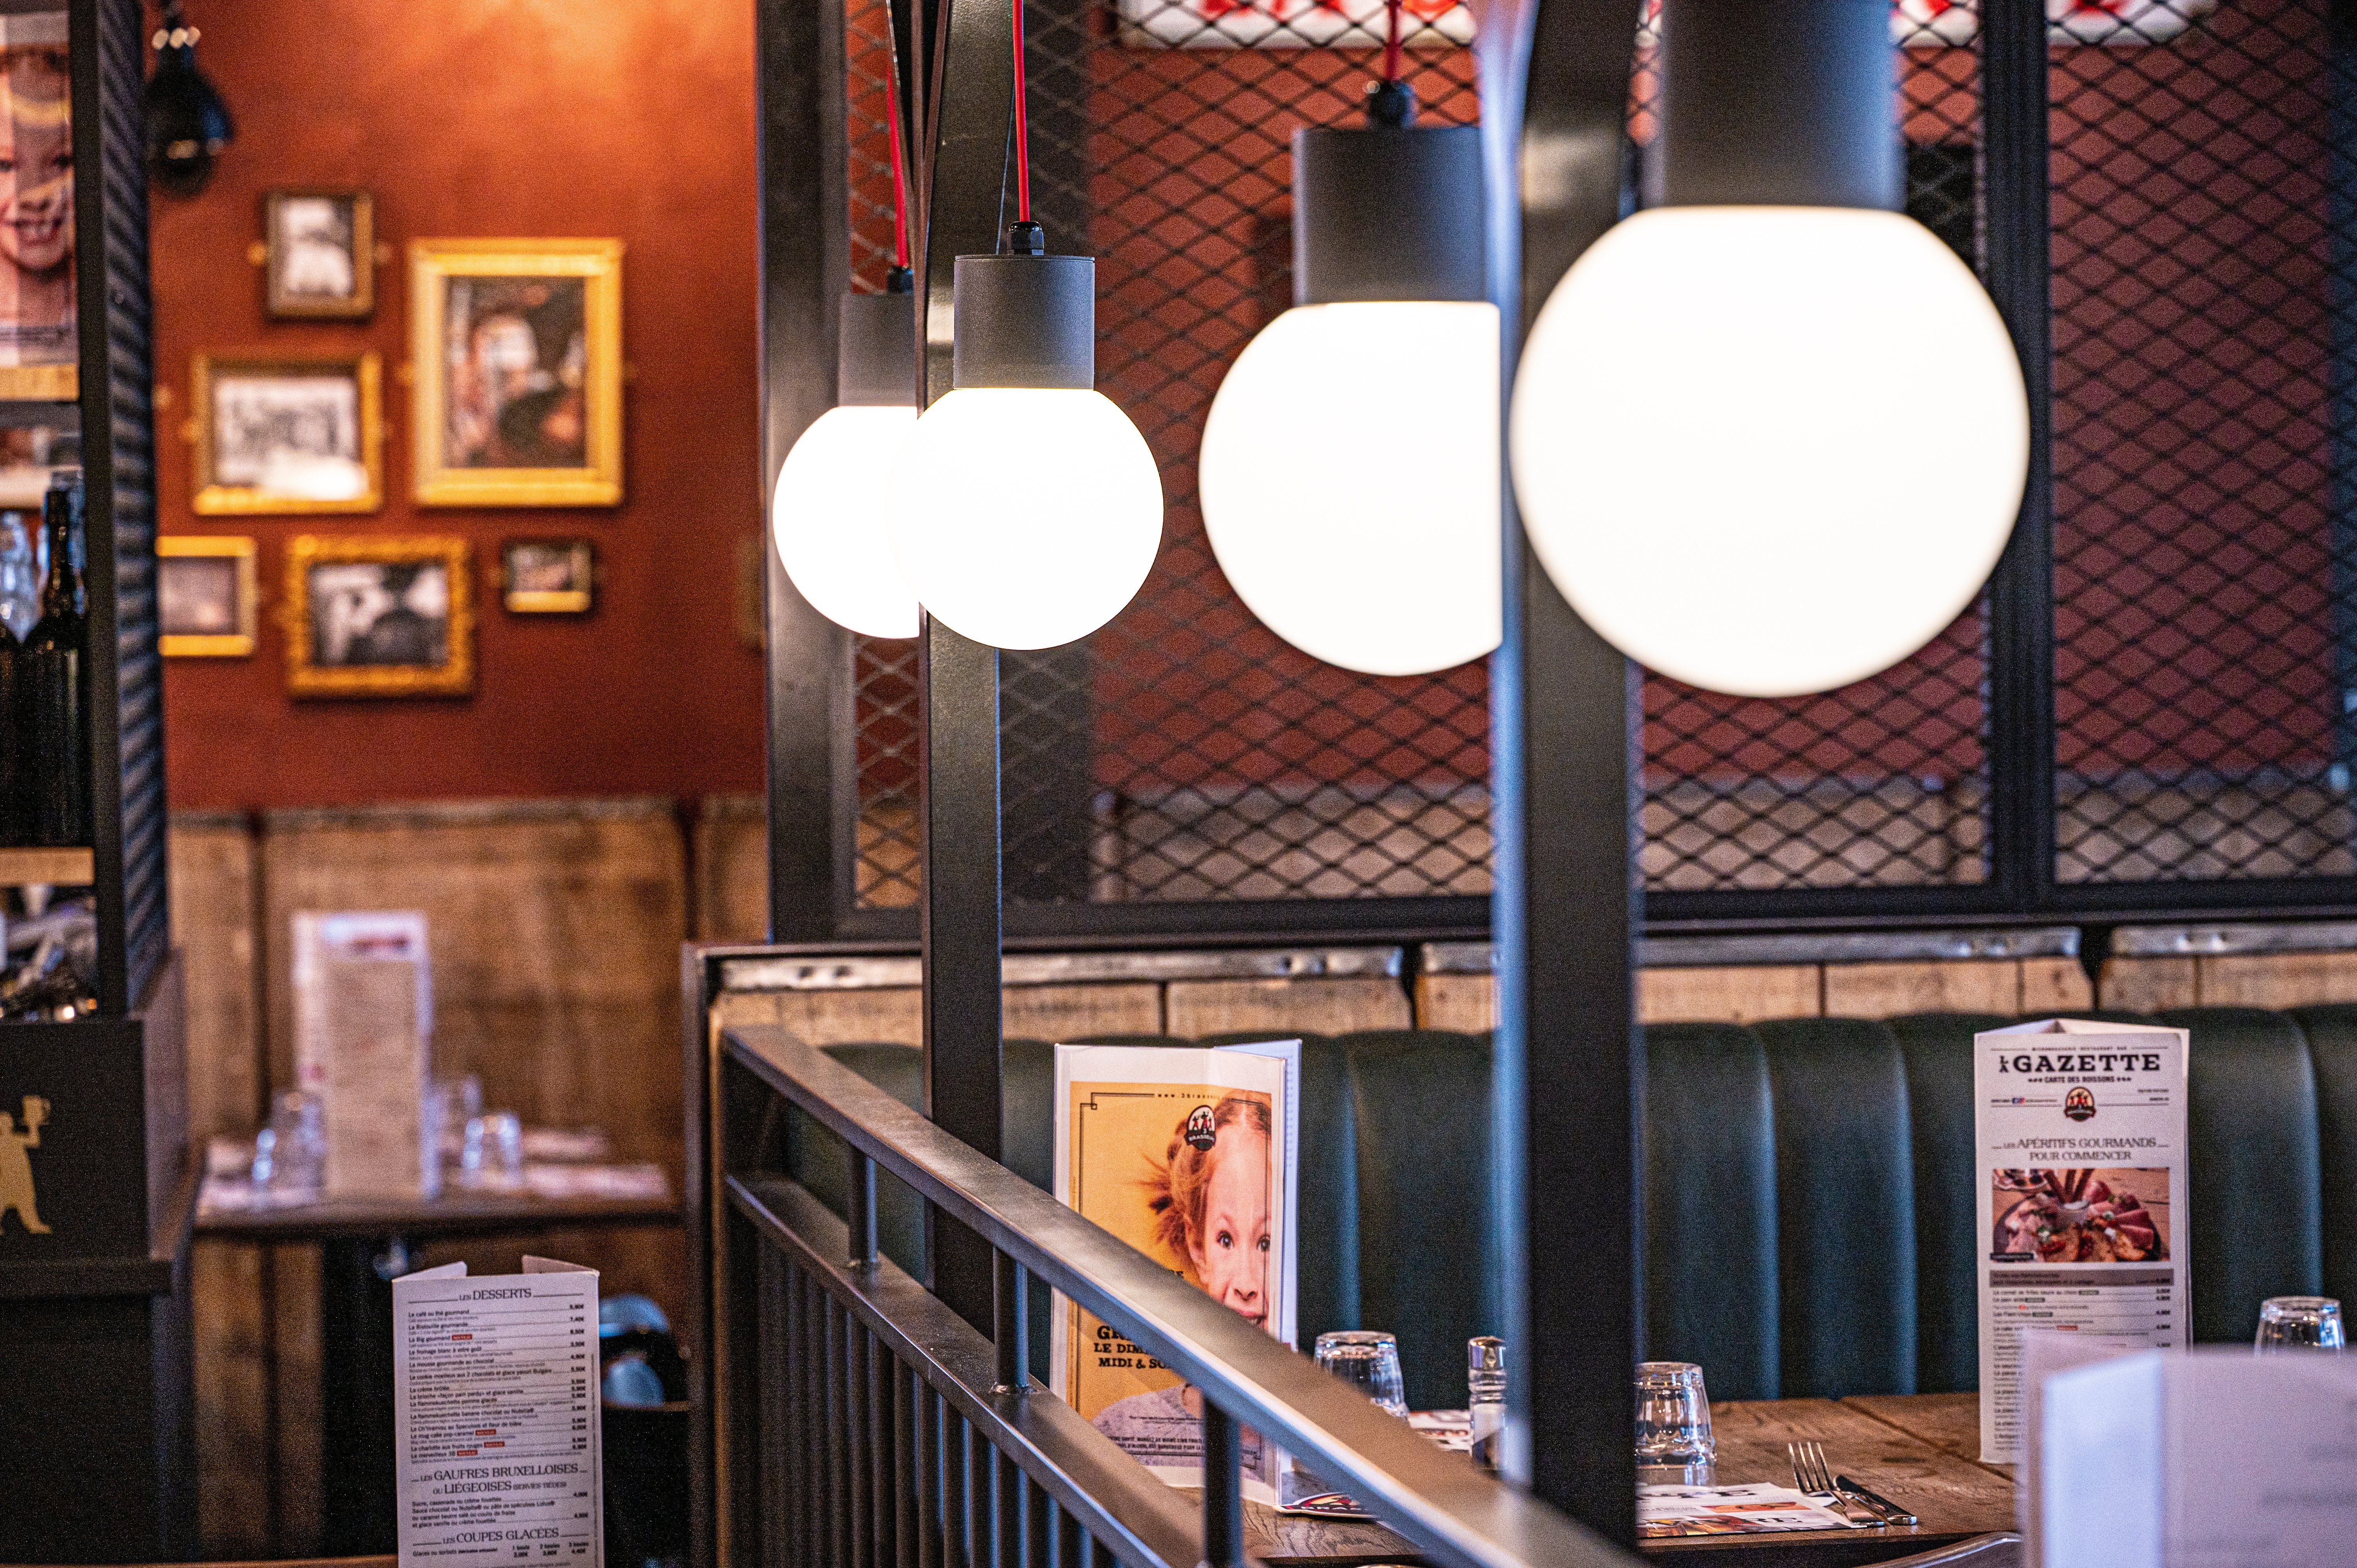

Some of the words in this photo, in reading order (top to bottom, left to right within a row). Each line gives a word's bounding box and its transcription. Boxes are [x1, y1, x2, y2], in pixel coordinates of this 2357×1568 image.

[2013, 1054, 2160, 1073] GAZETTE
[2078, 1137, 2157, 1149] GOURMANDS
[2029, 1151, 2061, 1161] POUR
[2062, 1151, 2132, 1161] COMMENCER
[473, 1287, 532, 1300] DESSERTS
[1094, 1343, 1111, 1353] LE
[1098, 1357, 1133, 1367] MIDI
[1136, 1358, 1146, 1369] &
[434, 1467, 489, 1481] GAUFRES
[492, 1462, 578, 1478] BRUXELLOISES
[444, 1481, 512, 1495] LIÉGEOISES
[456, 1531, 503, 1543] COUPES
[505, 1527, 559, 1540] GLACÉES
